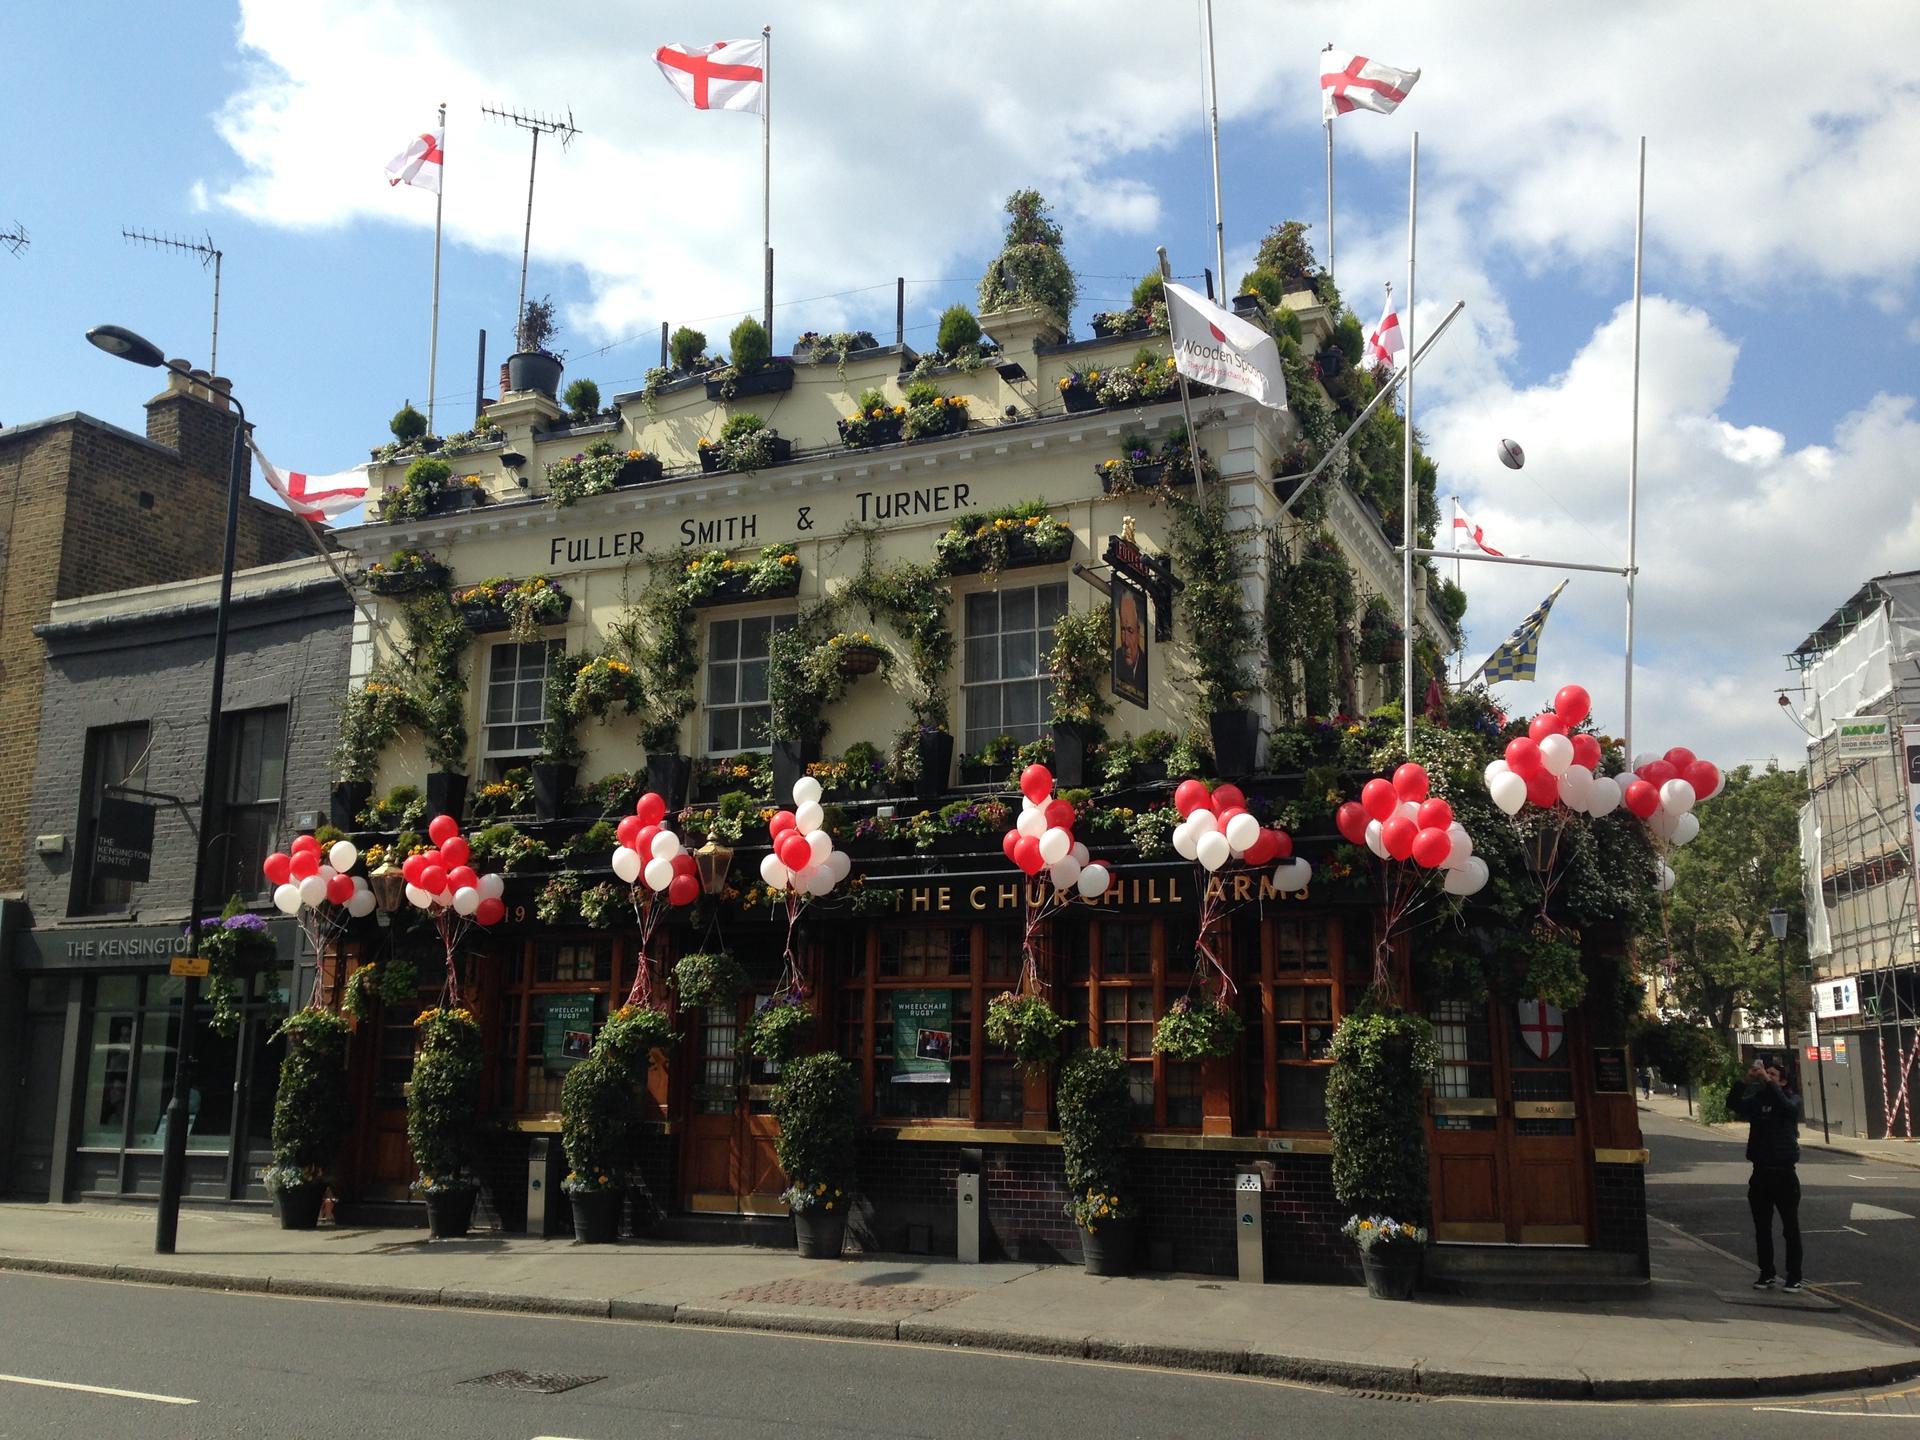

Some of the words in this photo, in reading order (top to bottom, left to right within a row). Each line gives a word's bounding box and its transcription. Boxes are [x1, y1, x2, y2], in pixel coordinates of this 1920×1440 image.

[1182, 338, 1233, 365] Wooden
[680, 513, 756, 547] SMITH
[796, 506, 814, 531] &
[98, 836, 114, 846] THE
[97, 846, 150, 860] KENSINGTON
[97, 854, 131, 866] DENTIST
[895, 887, 951, 912] THE
[67, 940, 95, 957] THE
